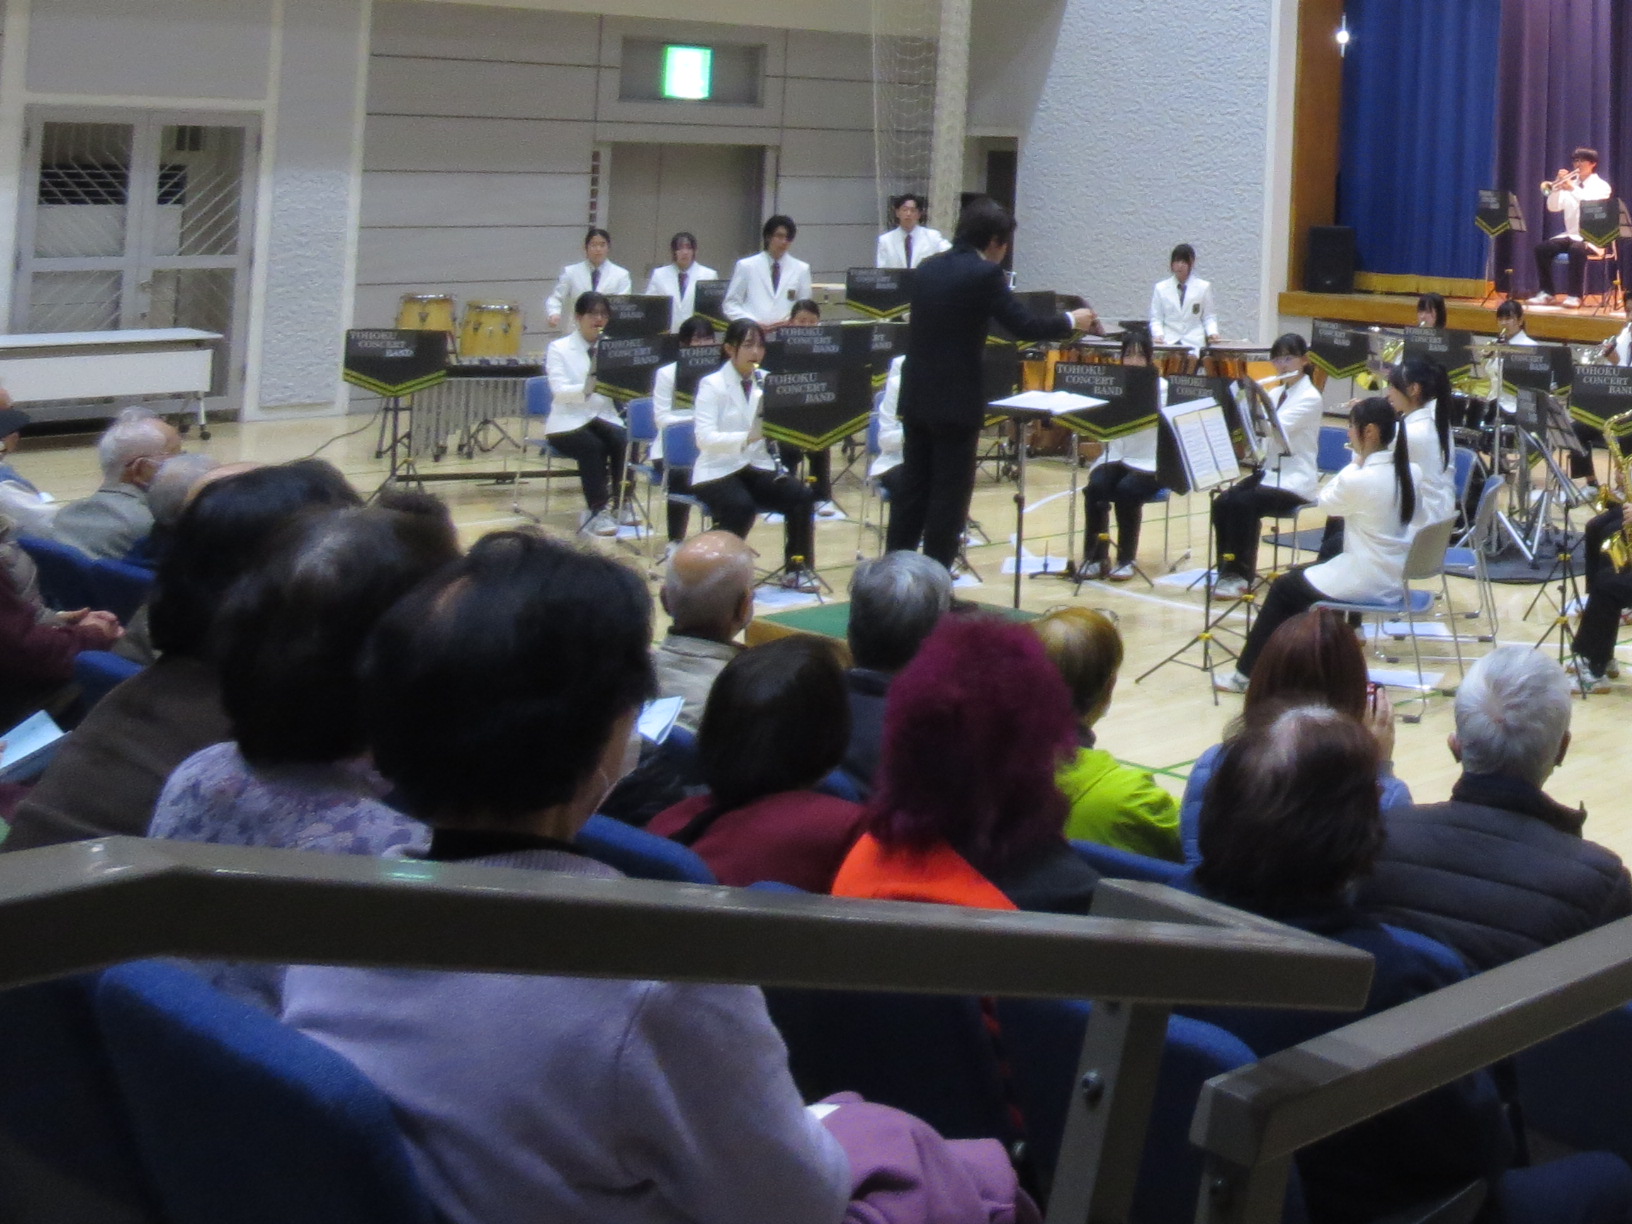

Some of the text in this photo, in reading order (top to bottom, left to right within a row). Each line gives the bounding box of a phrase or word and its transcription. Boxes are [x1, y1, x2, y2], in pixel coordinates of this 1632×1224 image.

[781, 328, 823, 336] TOHOKU
[787, 336, 832, 345] CONCERT
[681, 346, 721, 358] TOHOK
[688, 357, 717, 366] CONC
[1056, 364, 1105, 375] TOHOKU
[1575, 366, 1620, 376] TOHOKU
[769, 372, 818, 384] TOHOKU
[1065, 376, 1116, 386] CONCERT
[1583, 376, 1629, 386] CONCERT
[776, 383, 827, 394] CONCERT
[1094, 385, 1123, 396] BAND
[805, 392, 836, 404] BAND
